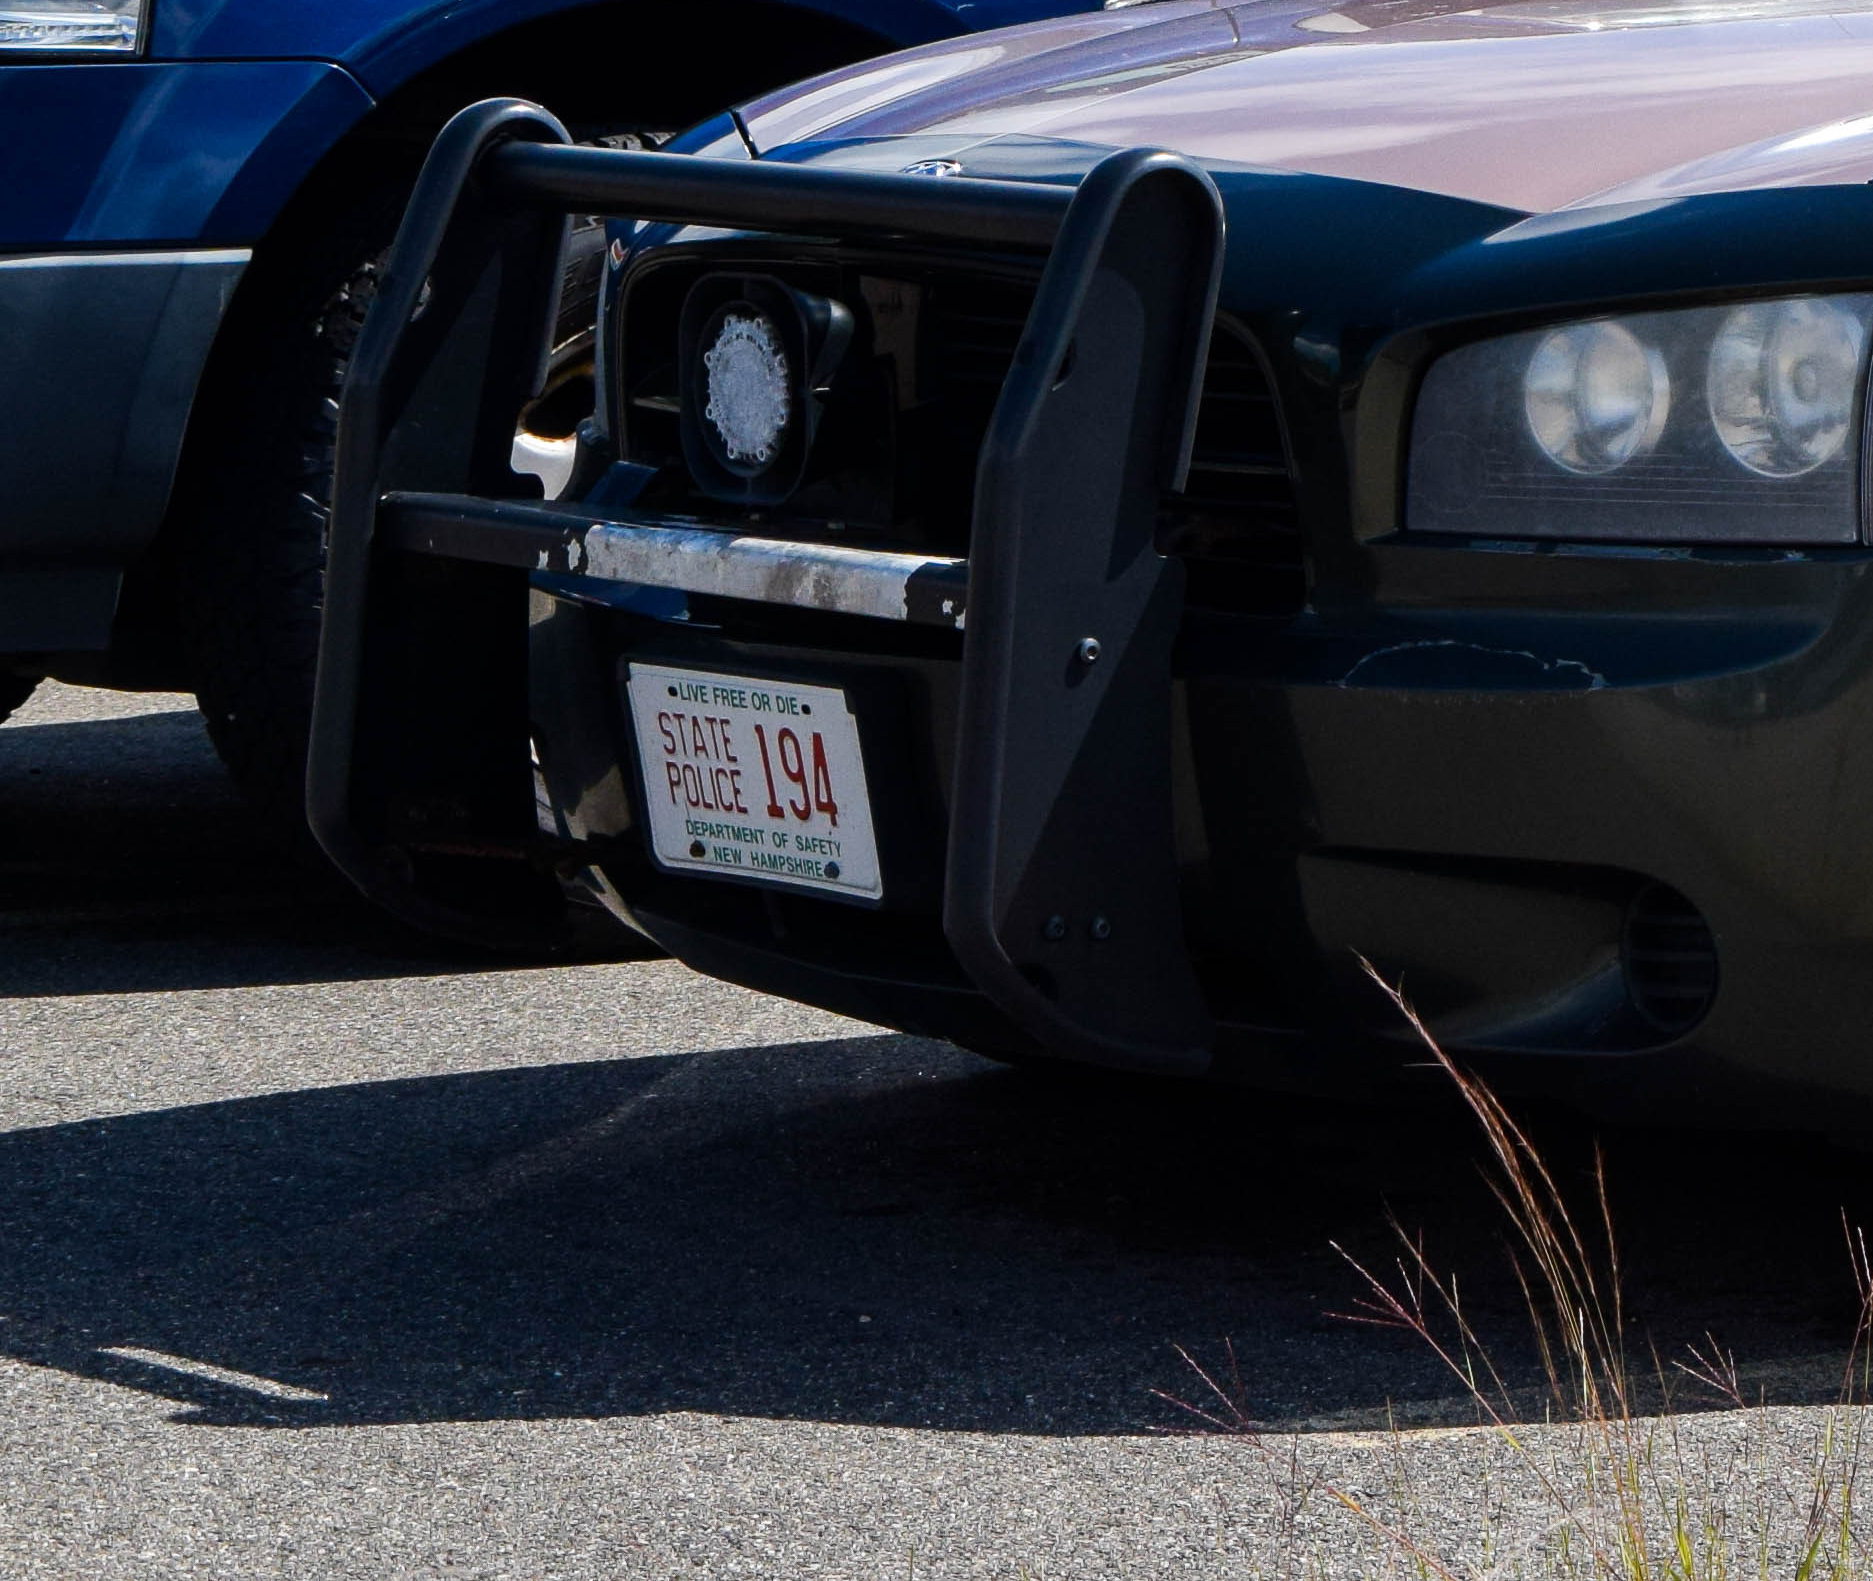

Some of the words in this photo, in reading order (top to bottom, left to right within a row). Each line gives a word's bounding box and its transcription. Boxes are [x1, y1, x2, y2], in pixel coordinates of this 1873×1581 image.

[679, 682, 708, 703] LIVE
[713, 687, 748, 709] FREE
[751, 692, 771, 712] OR
[776, 695, 800, 715] DIE
[658, 711, 738, 763] STATE
[665, 761, 748, 814] POLICE
[754, 723, 838, 827] 194
[685, 819, 766, 844] DEPARTMENT
[772, 830, 789, 849] OF
[796, 834, 842, 857] SAFETY
[713, 846, 742, 863] NEW
[750, 851, 824, 877] HAMPSHIRE
